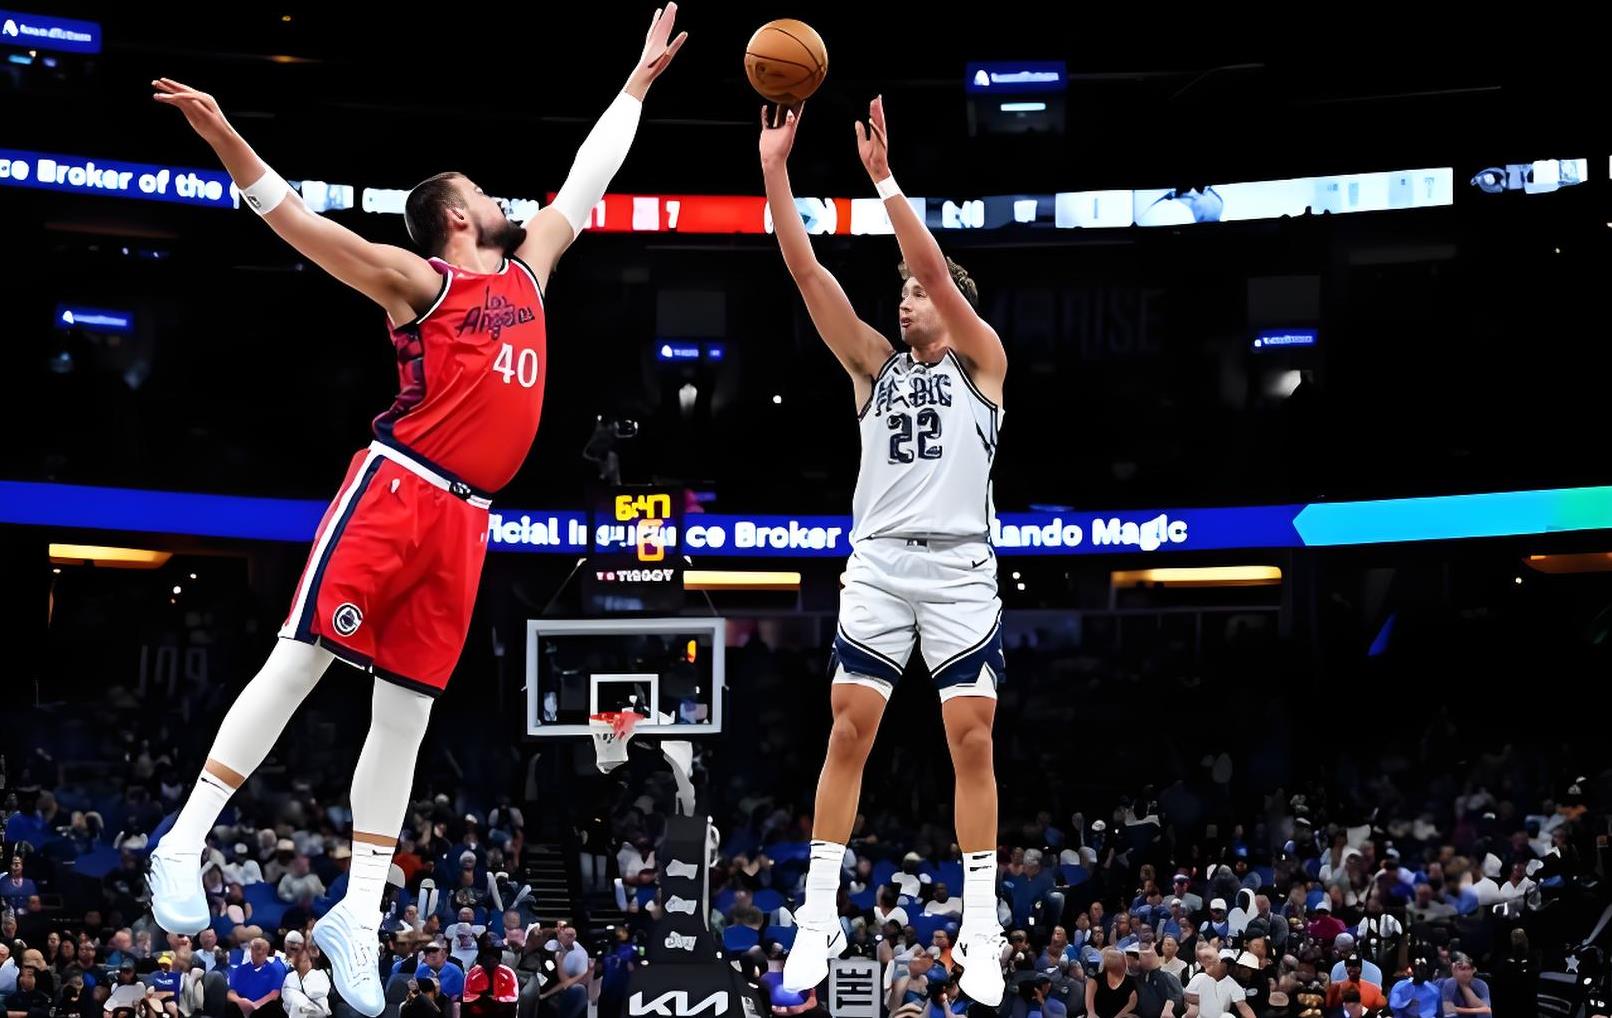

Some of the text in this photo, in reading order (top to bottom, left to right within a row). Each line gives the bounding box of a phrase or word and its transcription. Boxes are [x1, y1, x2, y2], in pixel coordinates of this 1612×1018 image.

[37, 159, 133, 190] Broker
[138, 169, 170, 195] of
[175, 172, 223, 201] the
[493, 342, 538, 388] 40
[887, 407, 943, 465] 22
[735, 521, 842, 549] Broker
[1092, 514, 1187, 551] Magic
[629, 990, 729, 1016] KIA
[836, 968, 873, 1010] THE
